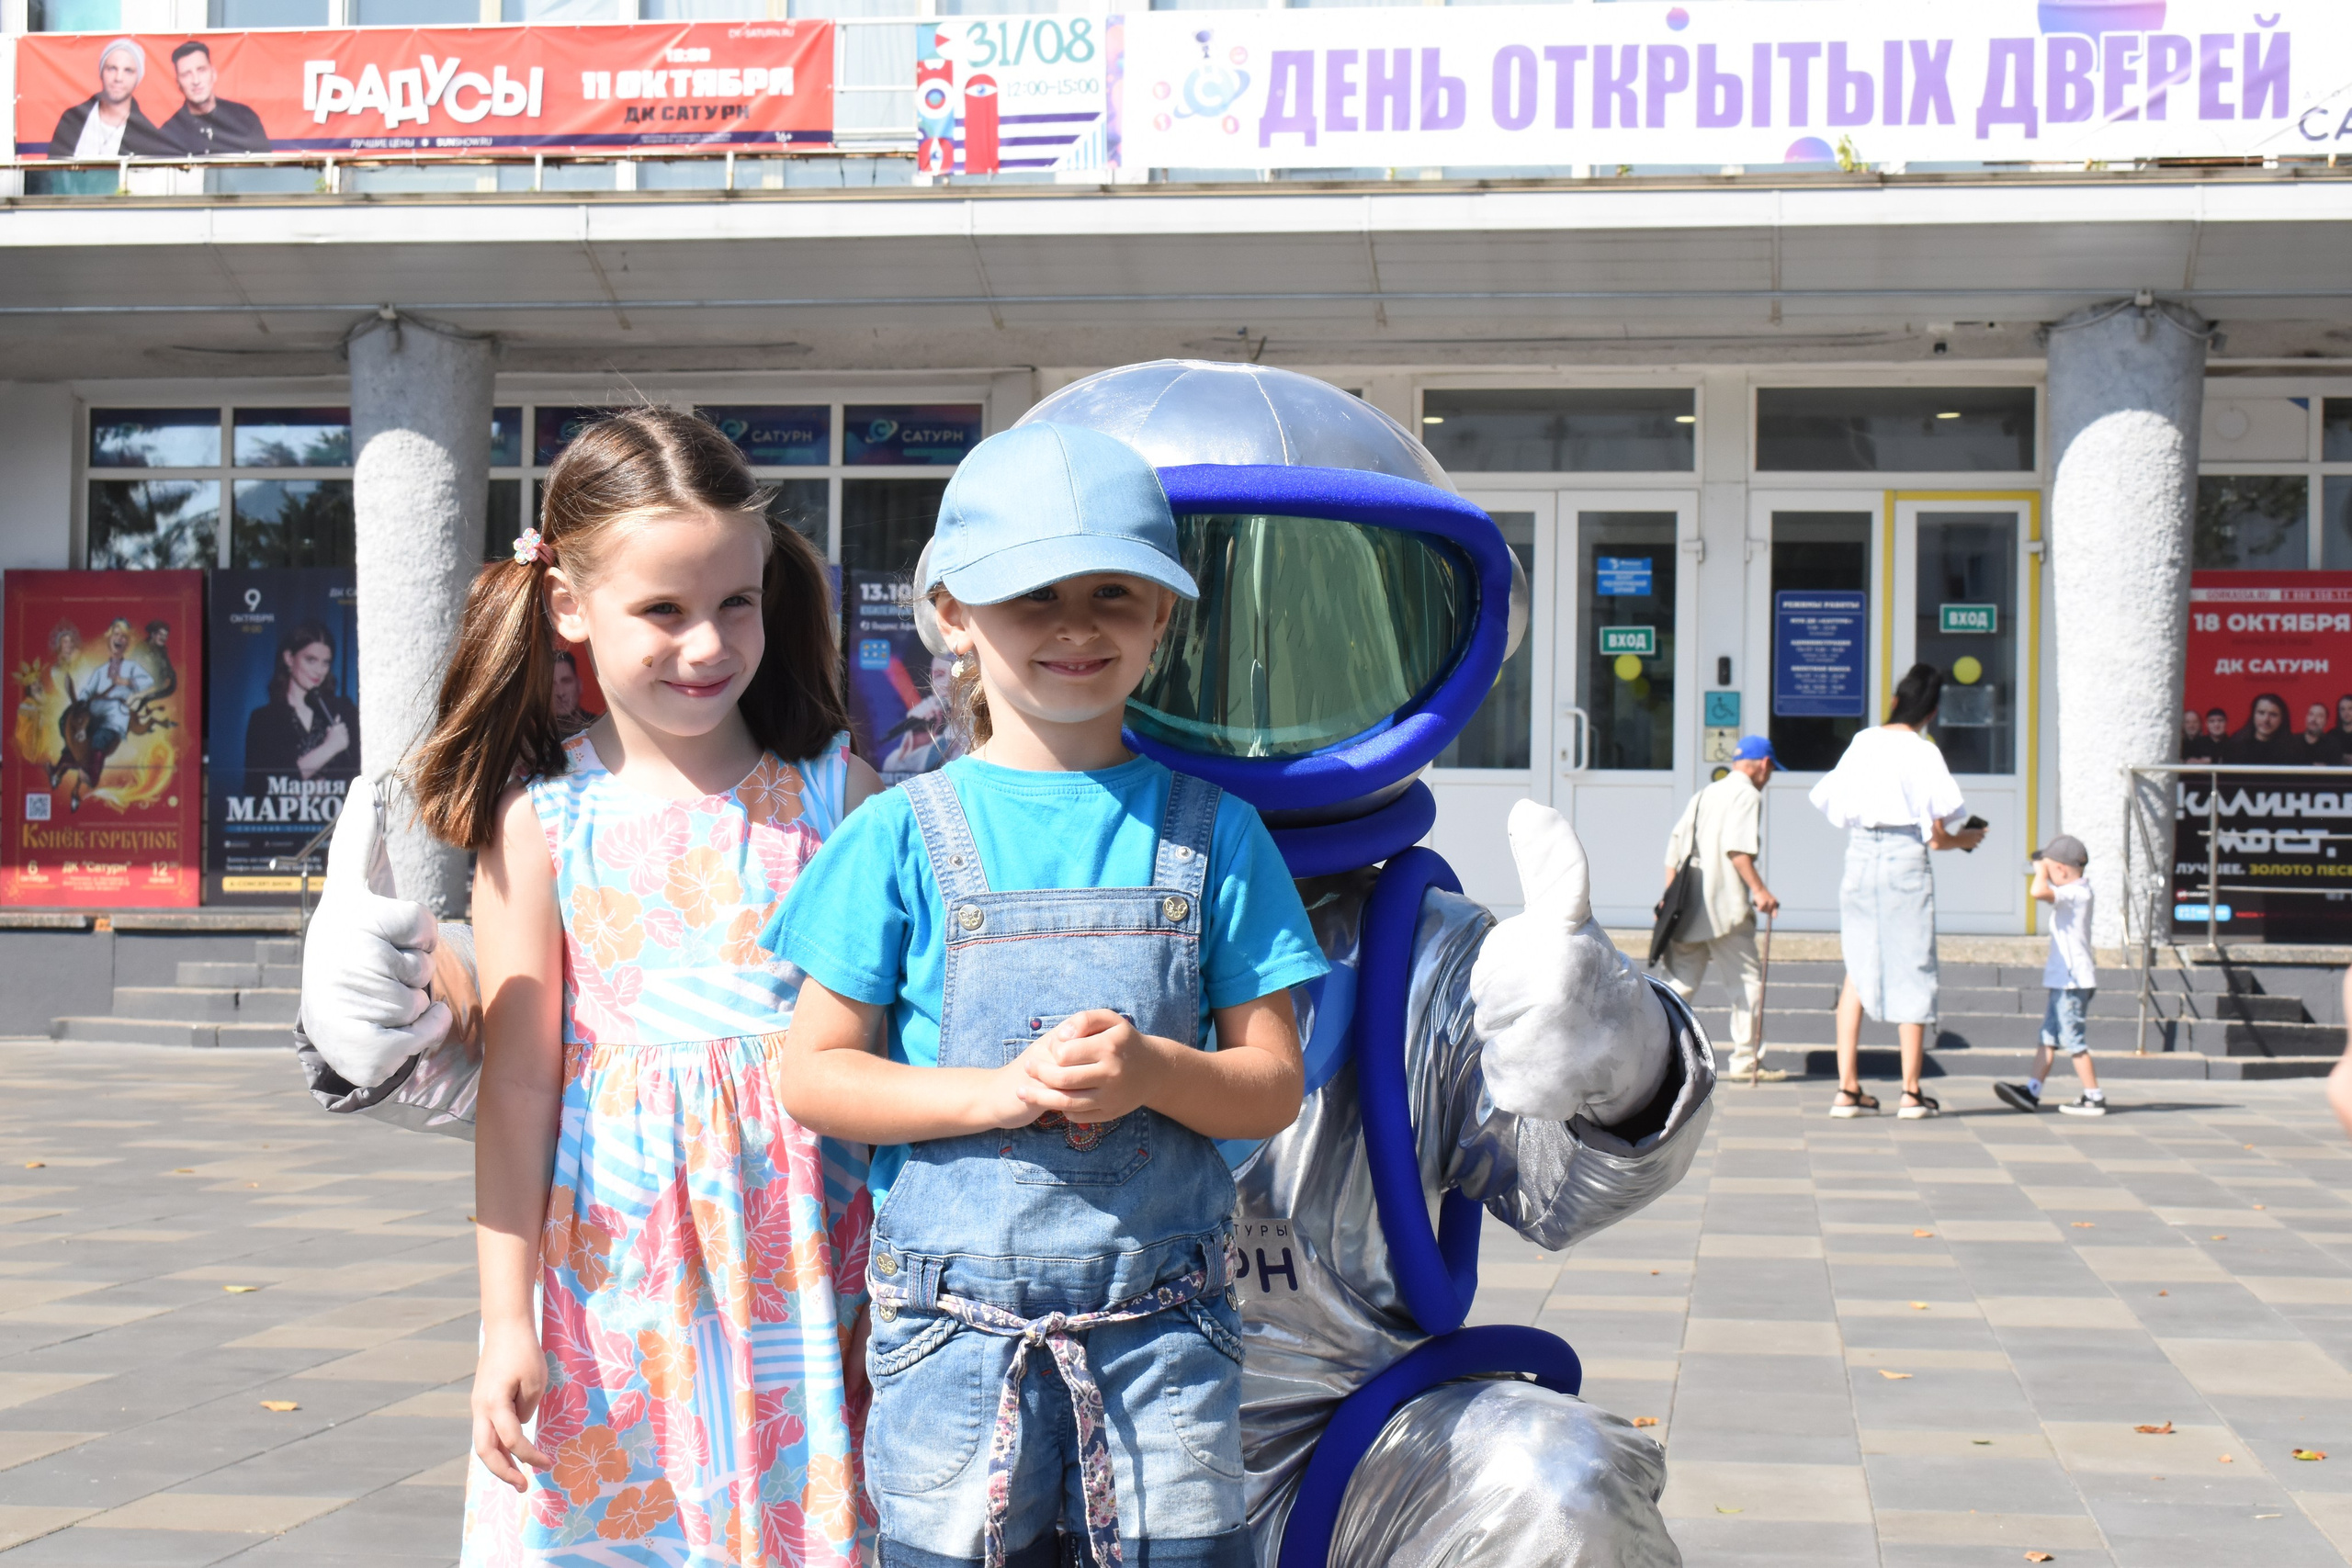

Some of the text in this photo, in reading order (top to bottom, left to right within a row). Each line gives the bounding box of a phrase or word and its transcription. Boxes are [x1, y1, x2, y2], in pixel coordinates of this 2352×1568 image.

[967, 17, 1095, 68] 31/08
[582, 66, 794, 99] 11 ОКТЯБРЯ
[1259, 13, 2291, 148] ДЕНЬ ОТКРЫТЫХ ДВЕРЕЙ
[624, 104, 750, 124] ДК САТУРН
[752, 429, 812, 443] САТУРН
[901, 429, 964, 443] САТУРН
[244, 588, 262, 613] 9
[1949, 611, 1988, 628] ВХОД
[2194, 614, 2351, 632] 18 ОКТЯБРЯ
[1608, 632, 1647, 649] ВХОД
[2214, 659, 2330, 675] ДК САТУРН
[267, 775, 346, 800] Мария
[28, 861, 39, 875] 6
[2249, 864, 2313, 876] ЗОЛОТО
